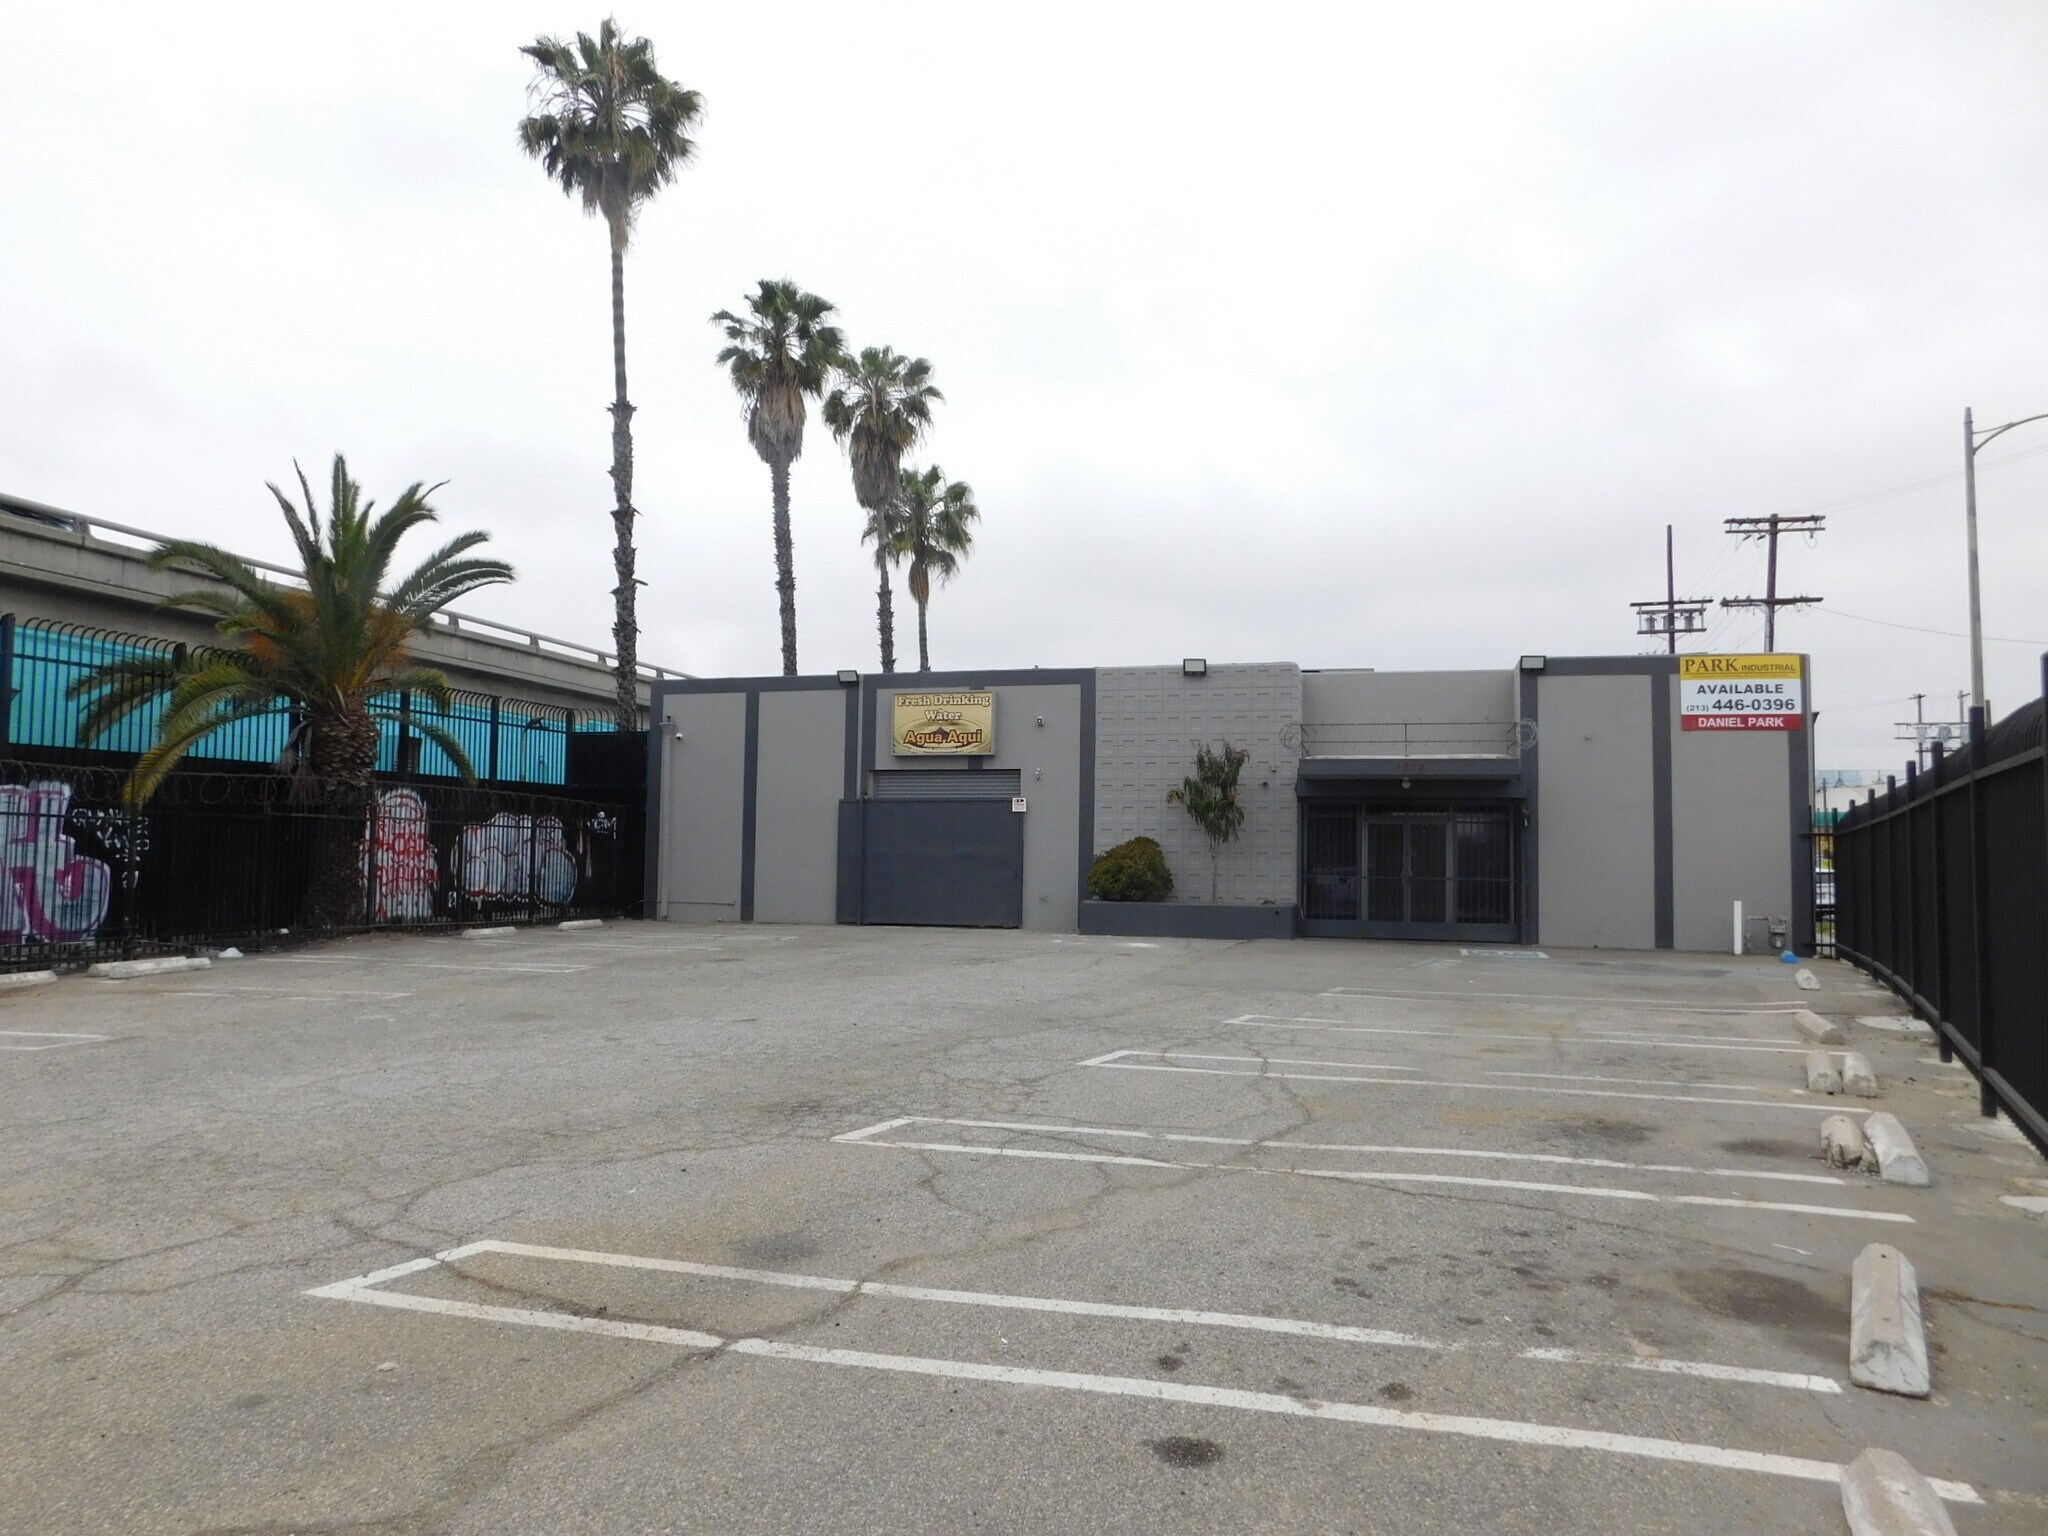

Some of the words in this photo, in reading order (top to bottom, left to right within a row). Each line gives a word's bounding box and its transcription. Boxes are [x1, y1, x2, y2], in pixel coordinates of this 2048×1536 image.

[1685, 658, 1739, 672] PARK
[1741, 663, 1796, 671] INDUSTRIAL
[1697, 684, 1784, 694] AVAILABLE
[897, 696, 932, 707] Fresh
[933, 695, 991, 707] Drinking
[1712, 698, 1796, 711] 446-0396
[925, 710, 962, 721] Water
[1698, 717, 1745, 728] DANIEL
[1748, 716, 1784, 727] PARK
[903, 730, 943, 745] Agua
[946, 729, 983, 745] Aqui
